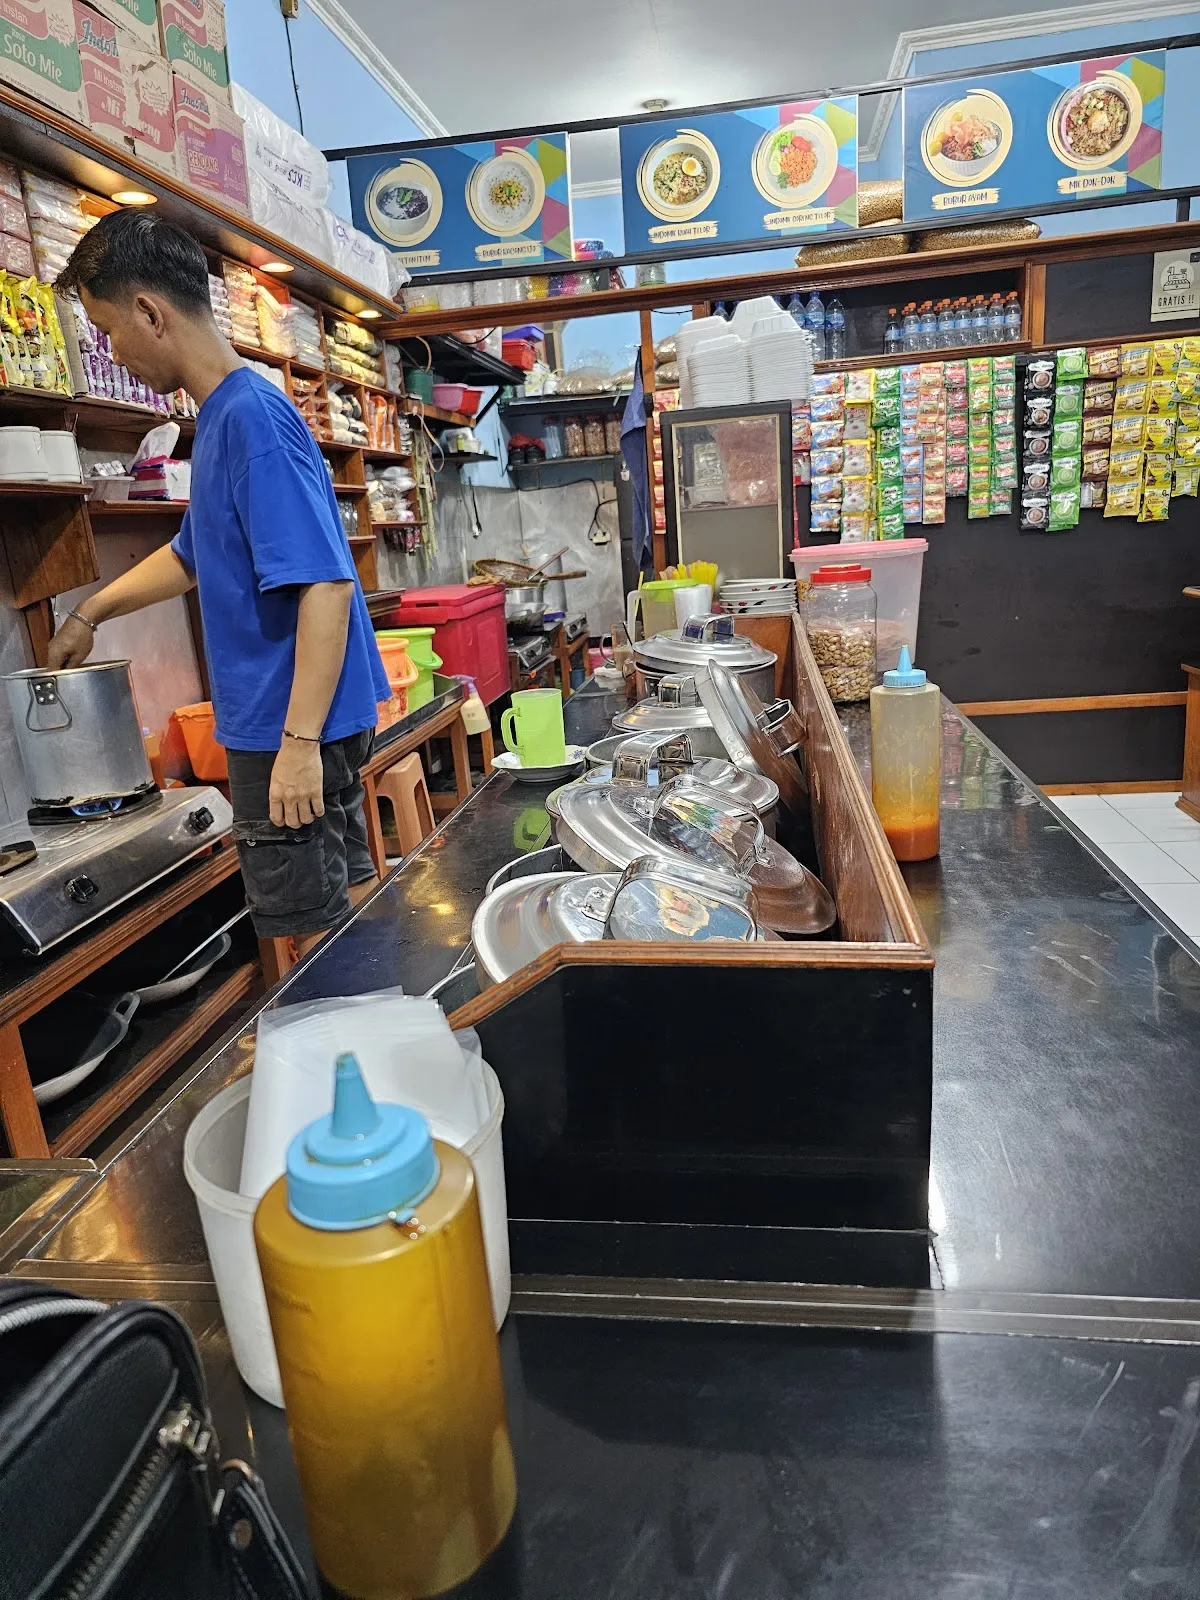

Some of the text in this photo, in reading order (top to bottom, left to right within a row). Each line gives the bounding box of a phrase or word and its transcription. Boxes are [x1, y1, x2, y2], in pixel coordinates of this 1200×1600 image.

[4, 34, 62, 83] Soto Mie
[183, 42, 202, 69] Soto
[203, 58, 217, 81] Mie
[93, 67, 104, 82] Mi
[188, 149, 219, 174] RENDANG
[1082, 175, 1116, 188] DON-DON
[943, 192, 988, 207] BUBUR AYAM
[1158, 295, 1186, 307] GRATIS
